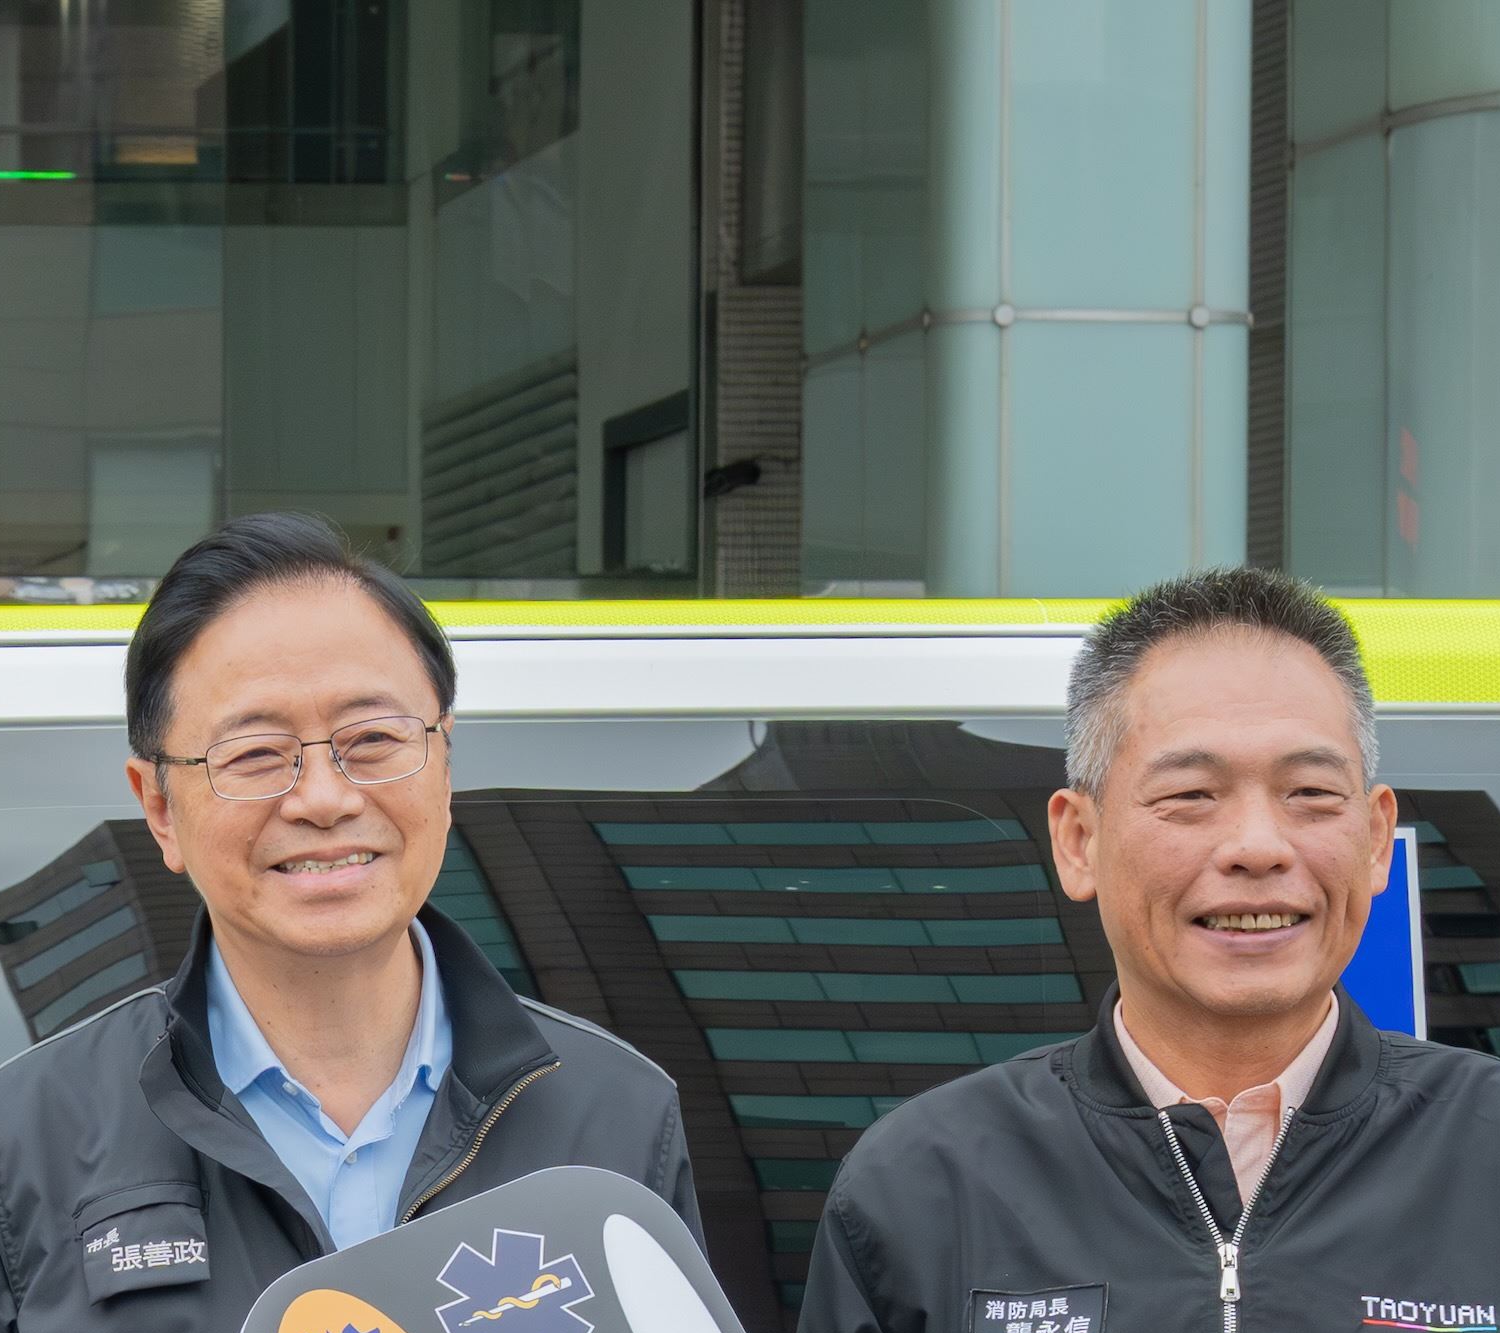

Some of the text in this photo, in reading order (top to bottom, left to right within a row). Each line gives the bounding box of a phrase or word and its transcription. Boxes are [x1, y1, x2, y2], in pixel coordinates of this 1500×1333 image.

[86, 1227, 120, 1254] 市長
[110, 1238, 207, 1272] 張善政
[985, 1297, 1070, 1320] 消防局長
[1360, 1295, 1497, 1325] TAOYUAN
